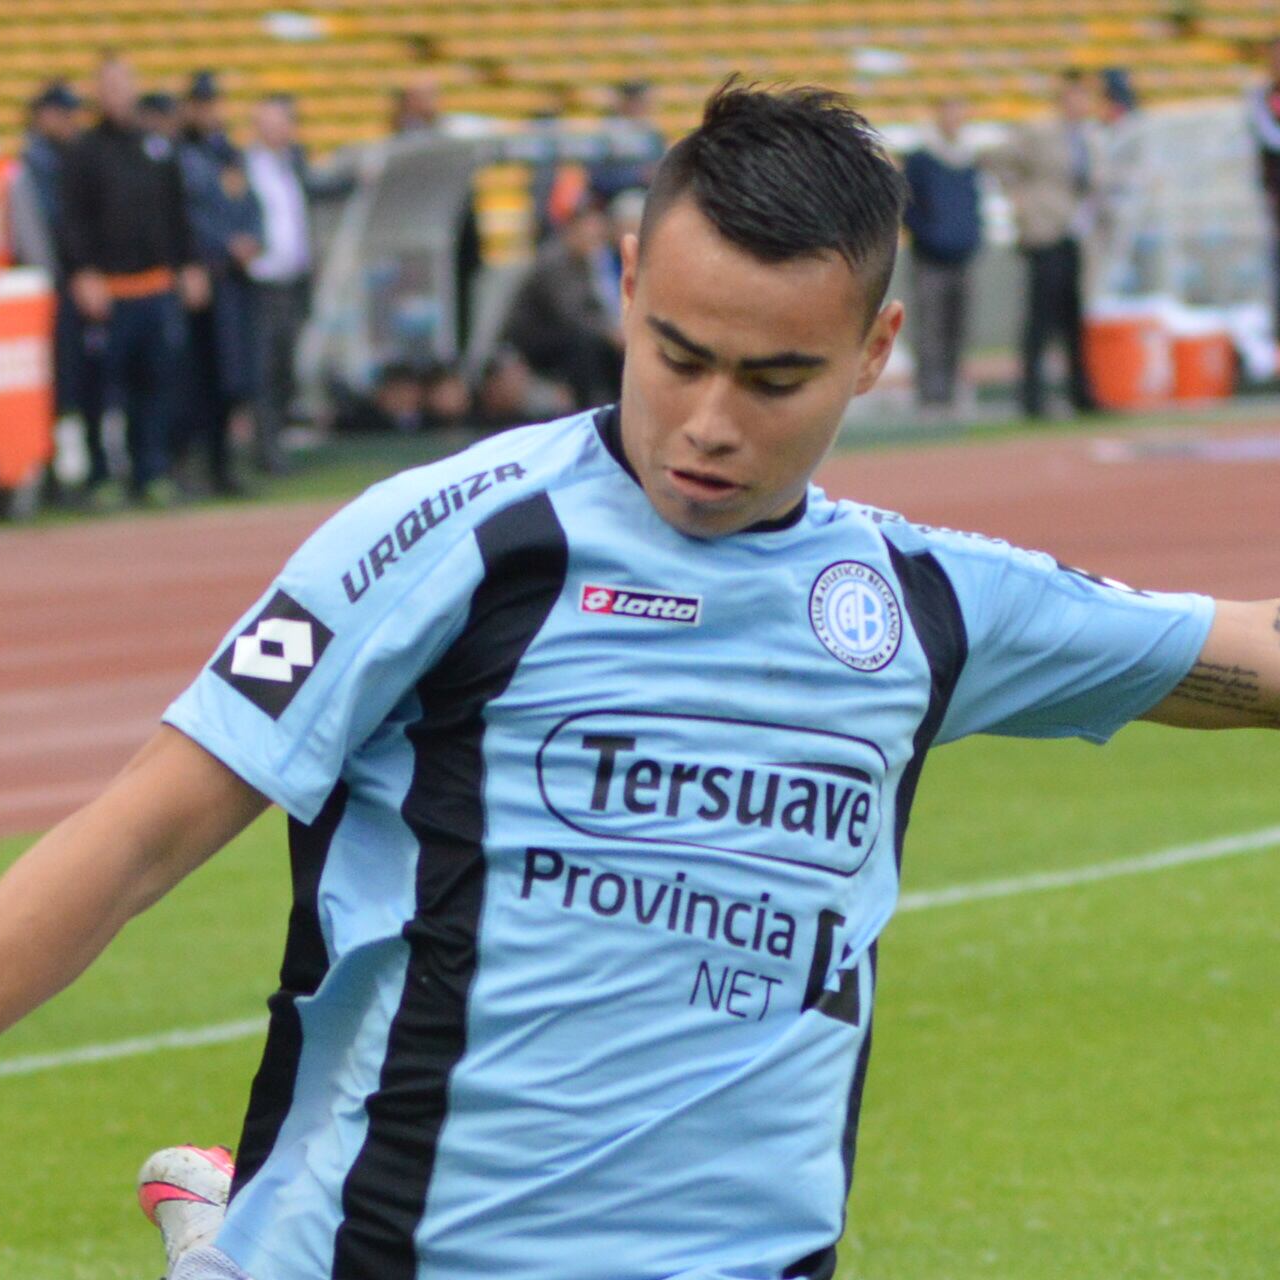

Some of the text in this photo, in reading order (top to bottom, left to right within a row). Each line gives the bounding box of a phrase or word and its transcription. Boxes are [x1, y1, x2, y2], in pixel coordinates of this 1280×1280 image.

[581, 735, 871, 847] Tersuave
[521, 847, 797, 960] Provincia
[689, 960, 783, 1021] NET
